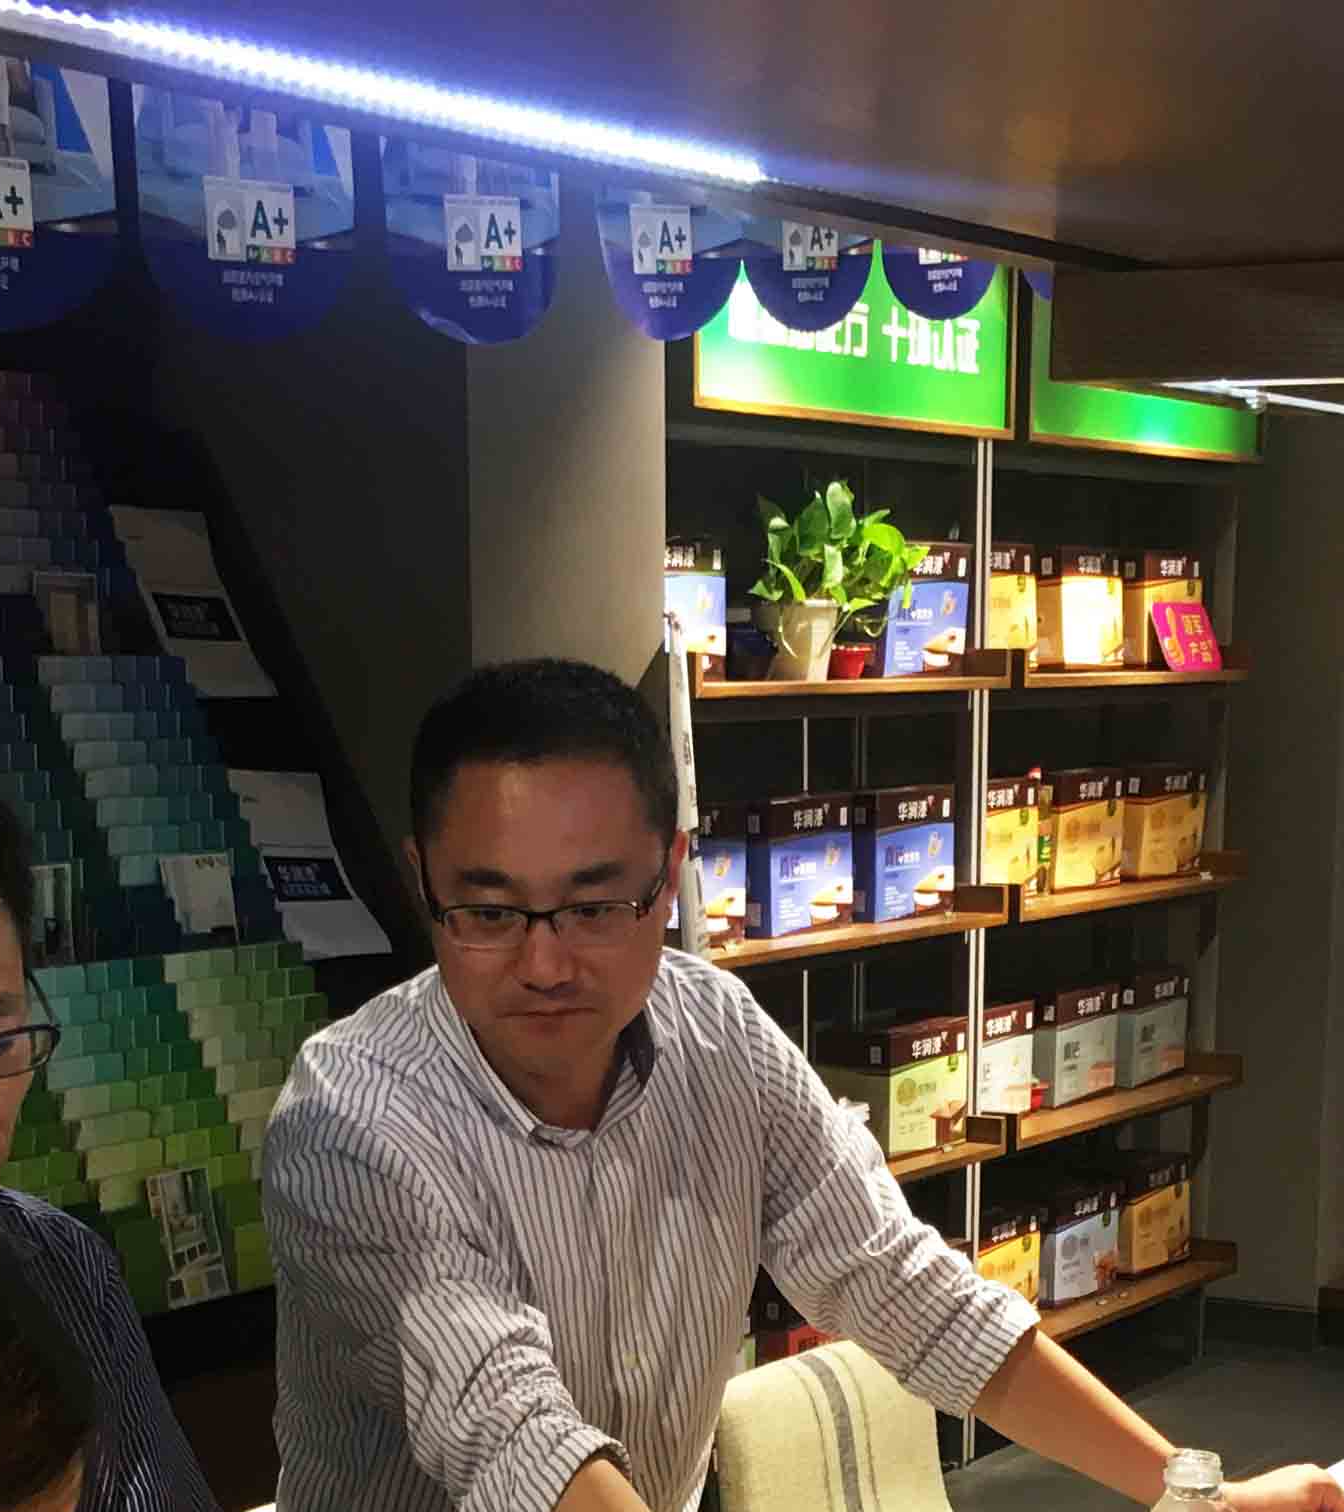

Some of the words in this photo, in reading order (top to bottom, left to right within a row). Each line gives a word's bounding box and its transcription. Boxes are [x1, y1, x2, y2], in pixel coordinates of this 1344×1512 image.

[251, 200, 289, 240] A+
[484, 213, 517, 249] A+
[659, 220, 687, 254] A+
[810, 226, 835, 252] A+
[793, 808, 824, 831] 华润漆
[897, 800, 928, 822] 华润漆
[986, 1016, 1012, 1037] 华润漆
[911, 1036, 942, 1059] 华润漆
